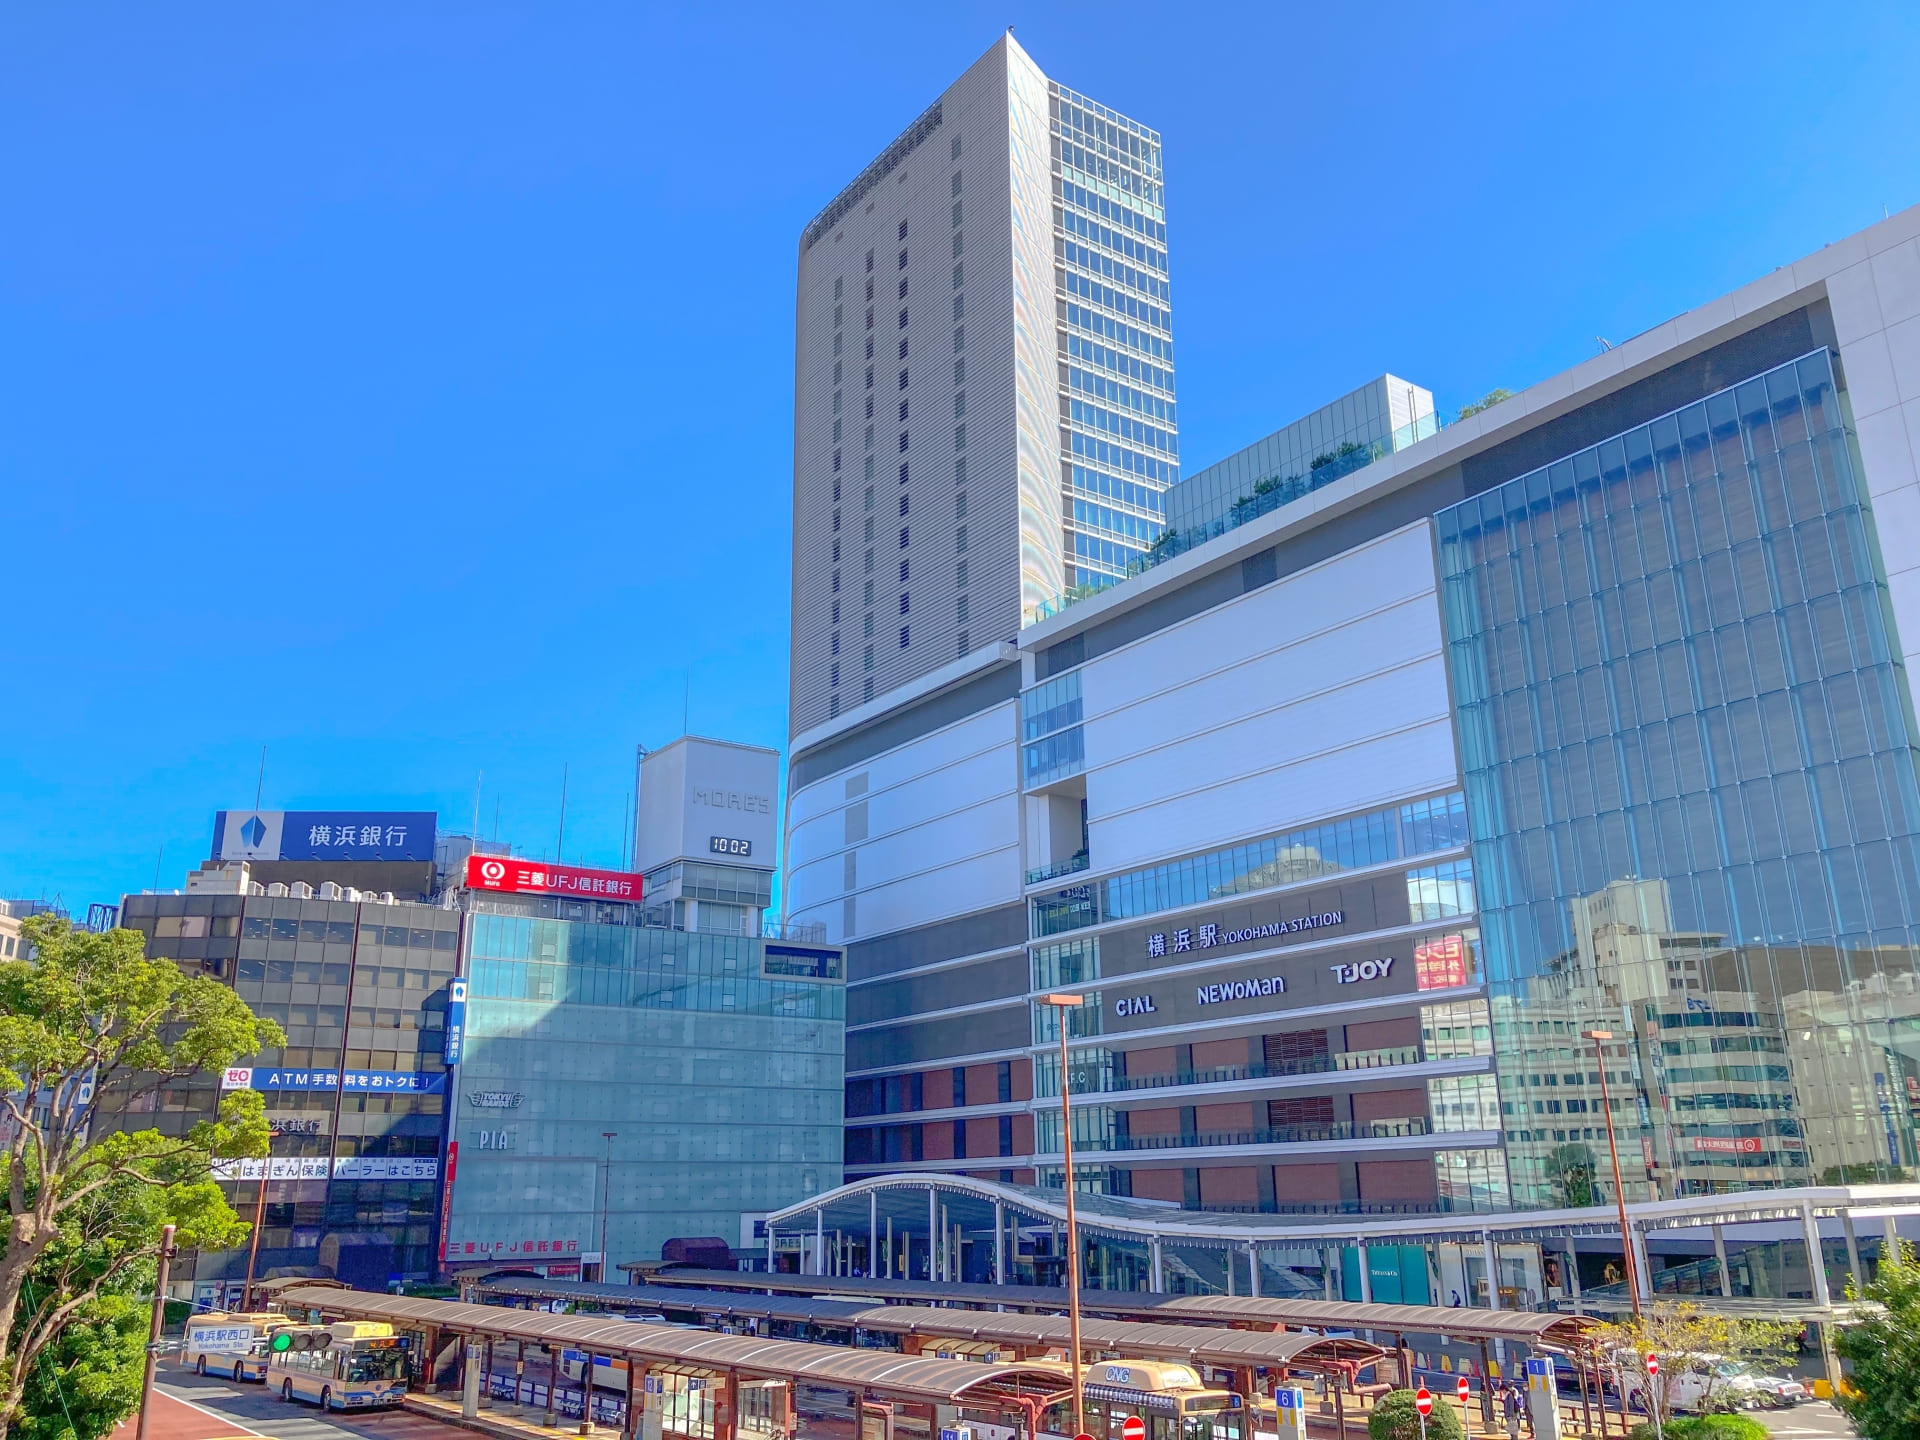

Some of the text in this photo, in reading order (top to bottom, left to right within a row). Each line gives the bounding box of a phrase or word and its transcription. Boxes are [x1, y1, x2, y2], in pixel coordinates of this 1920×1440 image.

[308, 825, 408, 847] 横浜銀行
[517, 870, 632, 896] 三菱UFJ信託銀行
[1148, 911, 1342, 958] 横浜駅 YOKOHAMA STATION
[1115, 995, 1156, 1017] CIAL
[483, 1092, 511, 1101] TOKYU
[270, 1117, 322, 1132] 浜銀行
[479, 1130, 508, 1150] PIA
[449, 1240, 578, 1254] 三菱UFJ信託銀行
[194, 1329, 249, 1342] 横浜駅西口
[1105, 1366, 1130, 1383] CNG
[1534, 1361, 1539, 1374] 1
[1281, 1391, 1289, 1406] 6
